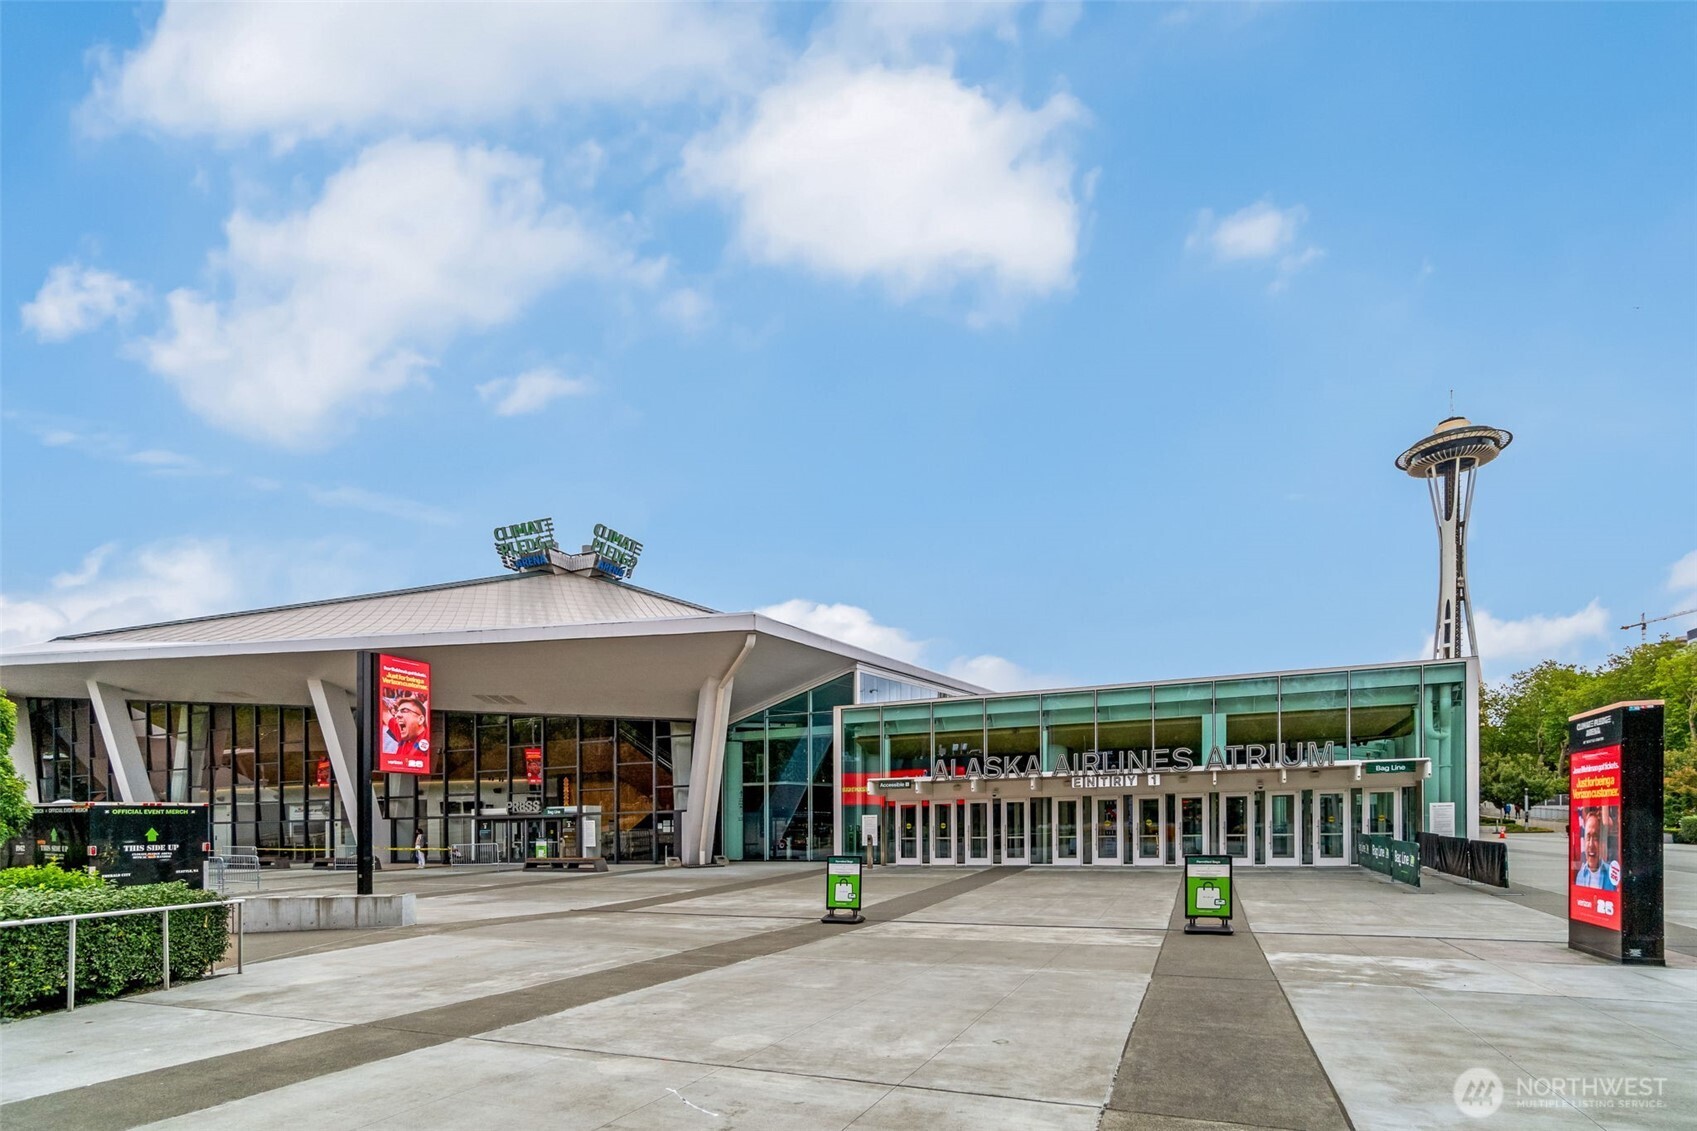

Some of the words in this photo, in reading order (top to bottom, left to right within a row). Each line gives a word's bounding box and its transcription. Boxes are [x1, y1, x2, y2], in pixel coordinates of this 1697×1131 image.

[494, 517, 554, 541] CLIMATE
[593, 523, 644, 556] CLIMATE
[515, 554, 548, 568] ARENA
[932, 755, 1042, 780] ALASKA
[1052, 747, 1194, 776] AIRLINES
[1204, 740, 1335, 771] ATRIUM
[1074, 775, 1136, 787] ENTRY
[123, 844, 145, 852] THIS
